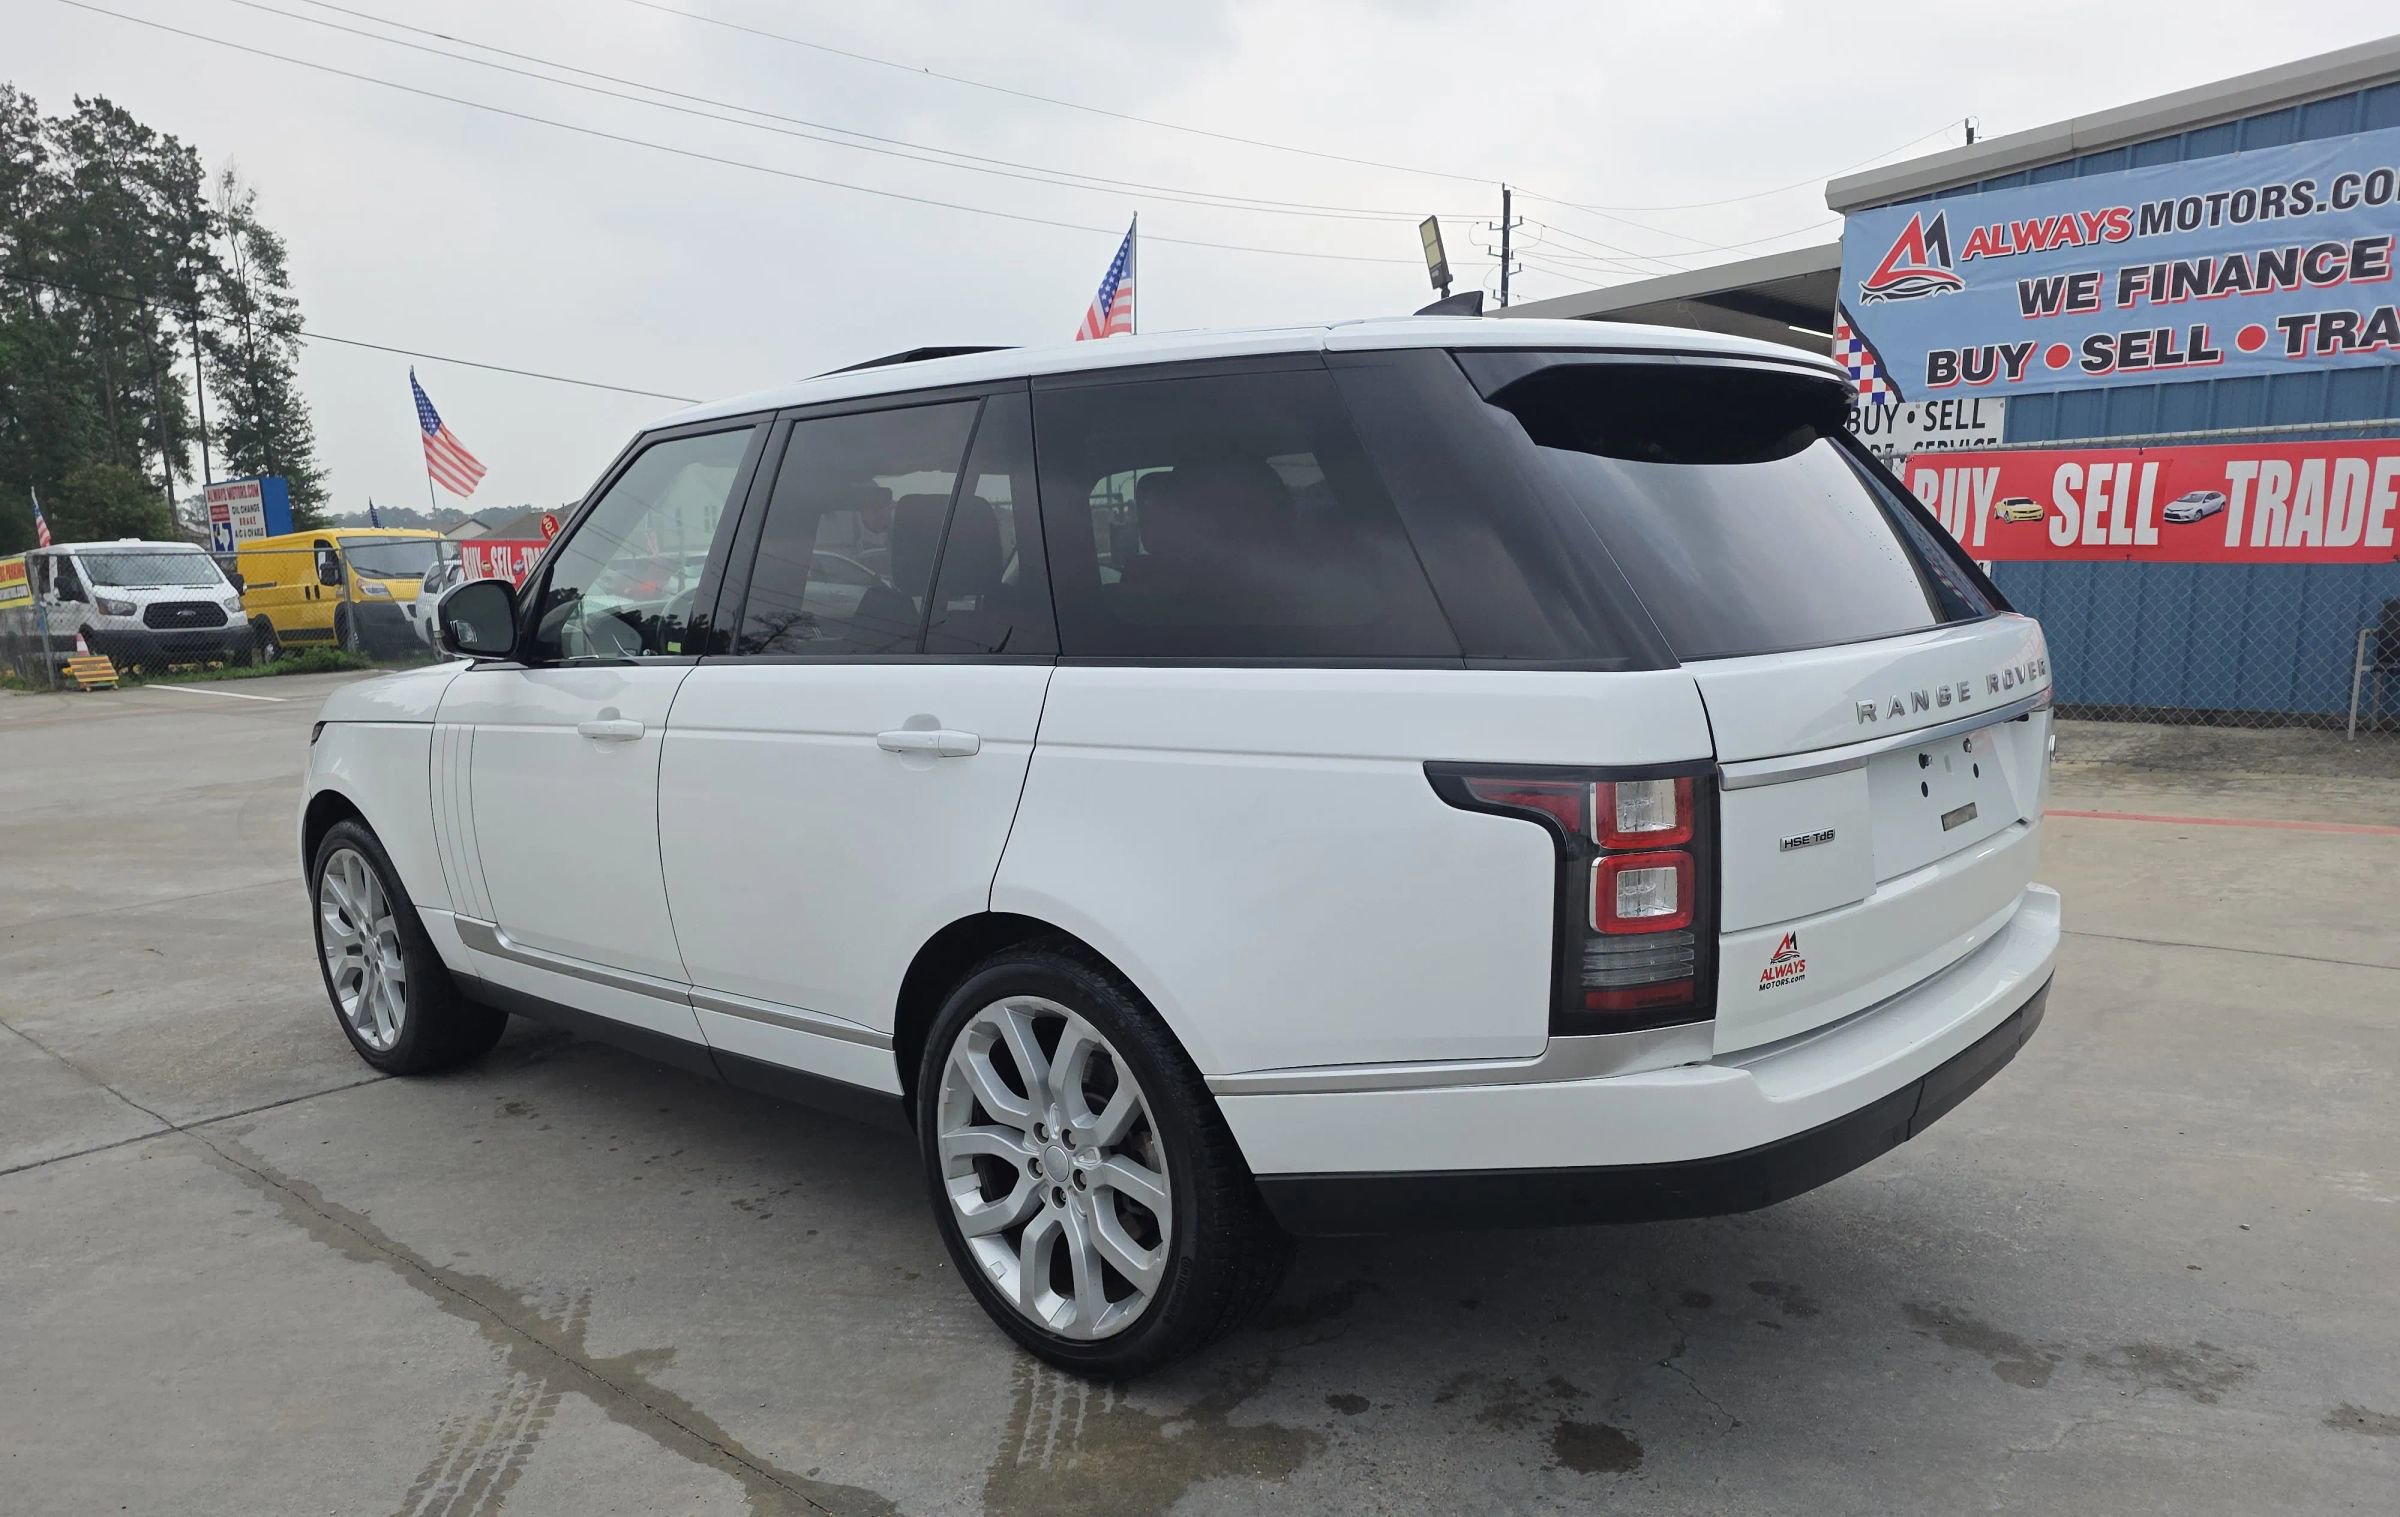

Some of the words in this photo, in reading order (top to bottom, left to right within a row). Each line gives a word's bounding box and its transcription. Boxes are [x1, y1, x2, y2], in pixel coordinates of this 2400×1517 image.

[1960, 206, 2135, 262] ALWAYS
[2137, 166, 2400, 238] MOTORS.CO
[2016, 270, 2104, 320] WE
[2115, 234, 2395, 309] FINANCE
[1925, 341, 2038, 393] BUY
[2079, 323, 2224, 377] SELL
[2276, 304, 2400, 361] TRA
[1847, 402, 1900, 435] BUY
[1923, 398, 1986, 432] SELL
[1913, 466, 2000, 547] BUY
[2048, 461, 2159, 548] SELL
[2224, 456, 2400, 547] TRADE
[490, 545, 516, 584] SELL
[1856, 681, 1971, 725] RANGE
[1986, 657, 2047, 696] ROVER
[1784, 834, 1810, 849] HSE
[1813, 829, 1834, 842] Td6
[1758, 974, 1806, 992] MOTORS.com
[1760, 959, 1806, 983] ALWAYS
